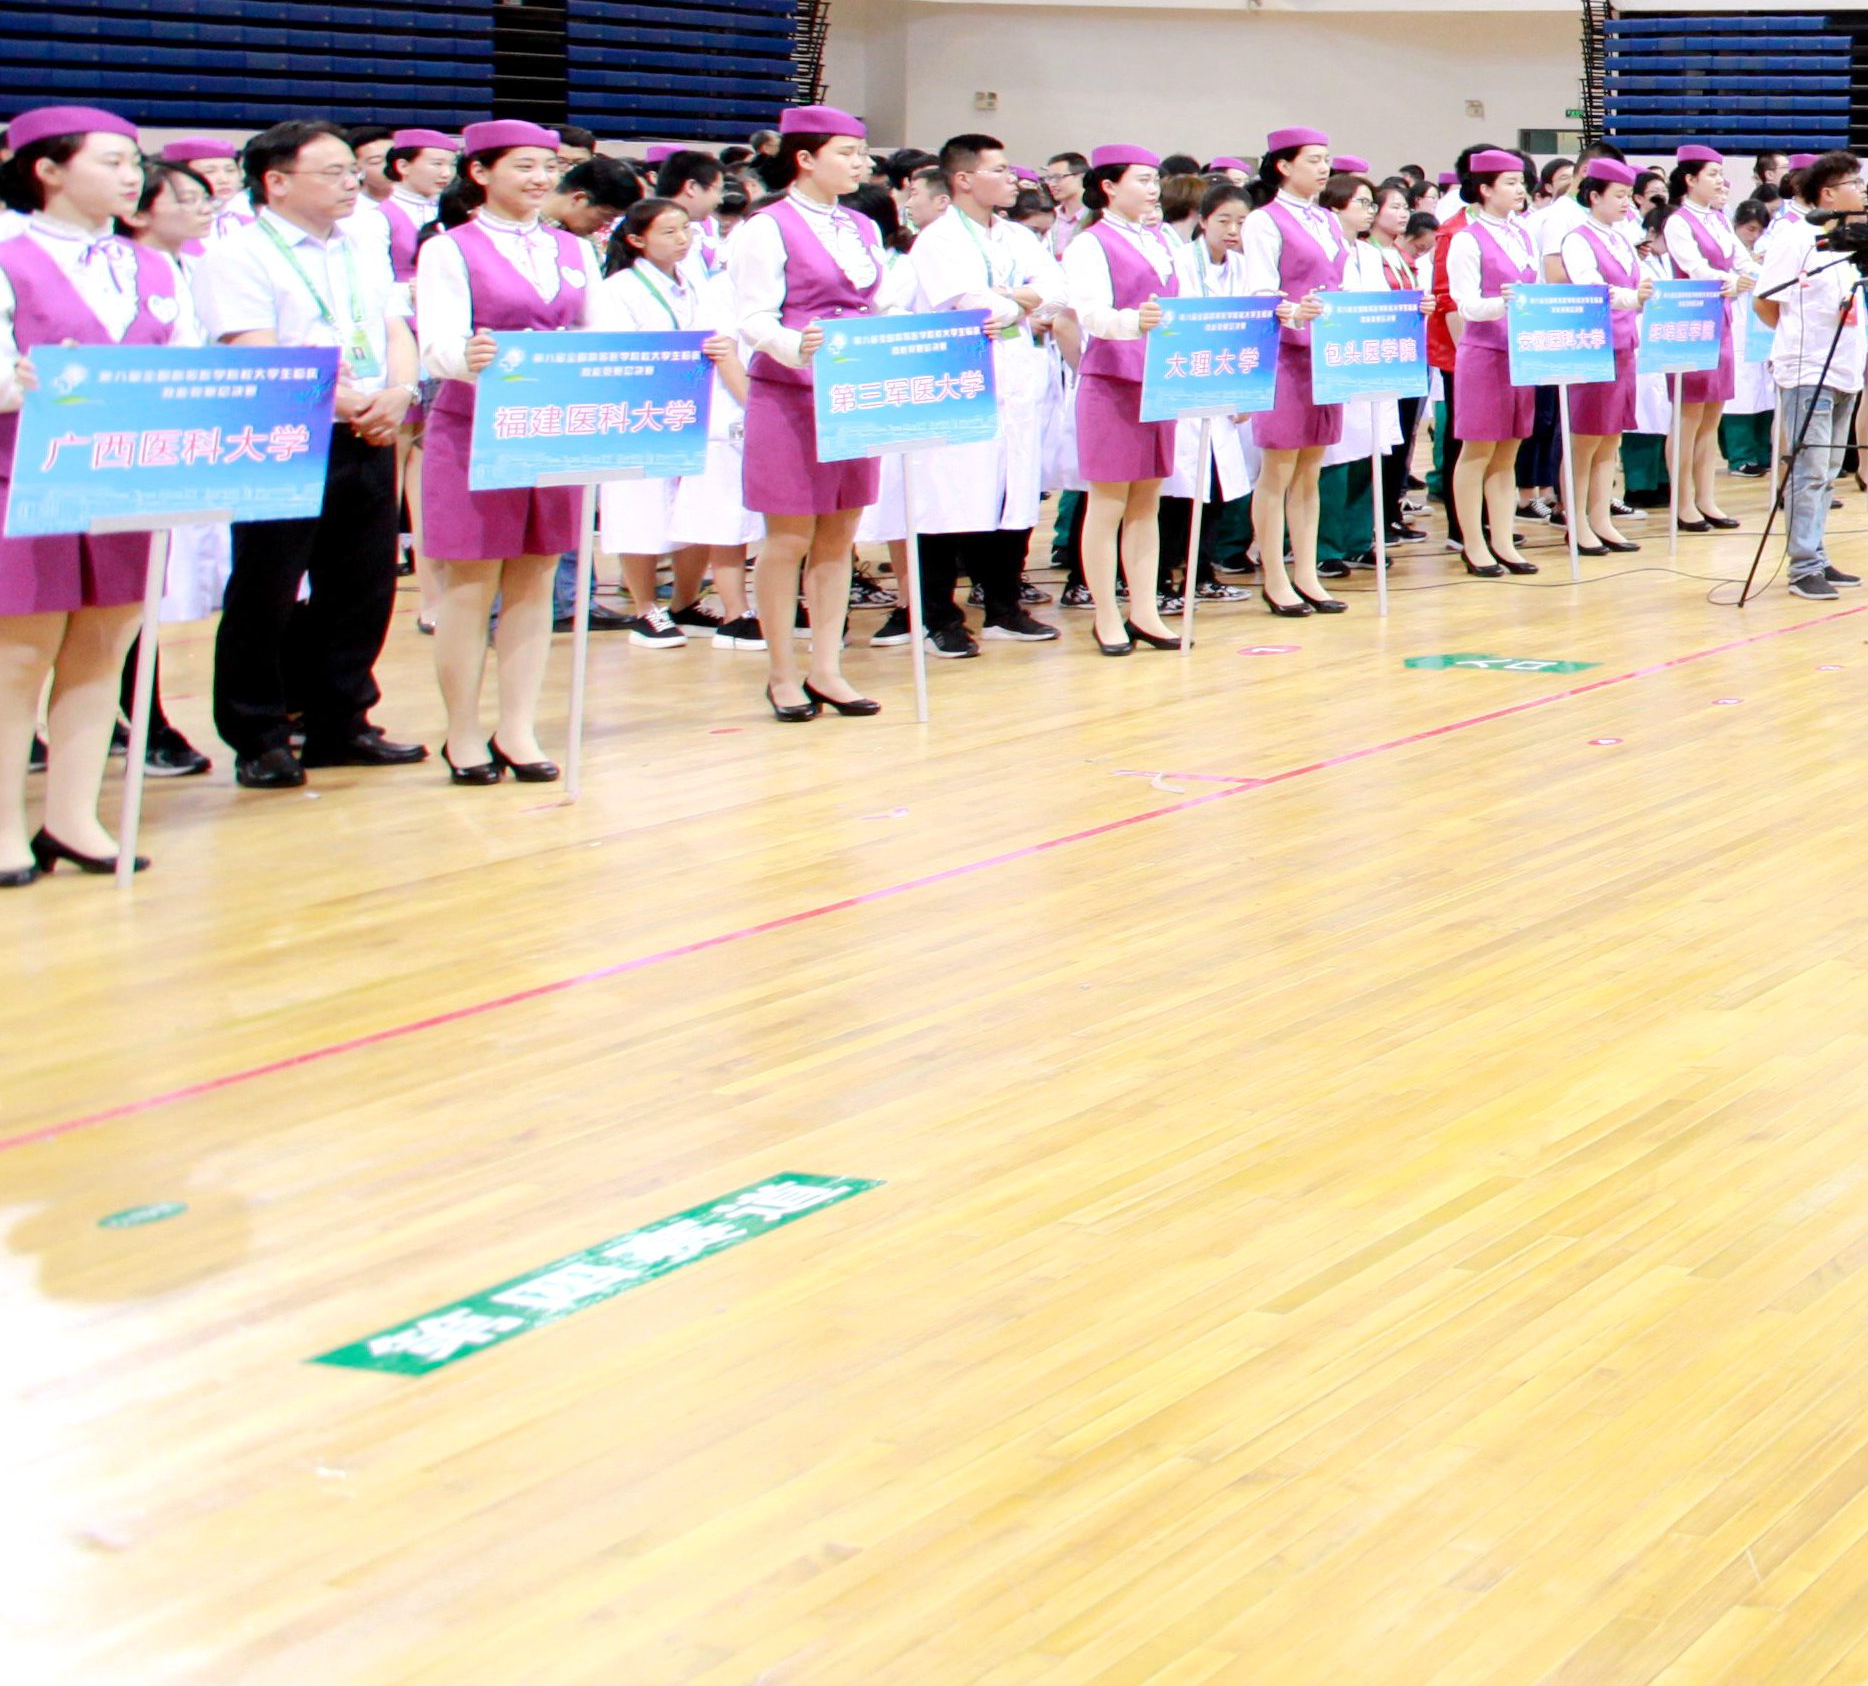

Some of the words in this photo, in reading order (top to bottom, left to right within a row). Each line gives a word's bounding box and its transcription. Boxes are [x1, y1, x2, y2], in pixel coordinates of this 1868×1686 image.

[1164, 346, 1261, 379] 大理大学
[1324, 337, 1418, 366] 包头医学院
[830, 370, 985, 413] 第三军医大学
[494, 399, 697, 439] 福建医科大学
[41, 423, 311, 473] 广西医科大学
